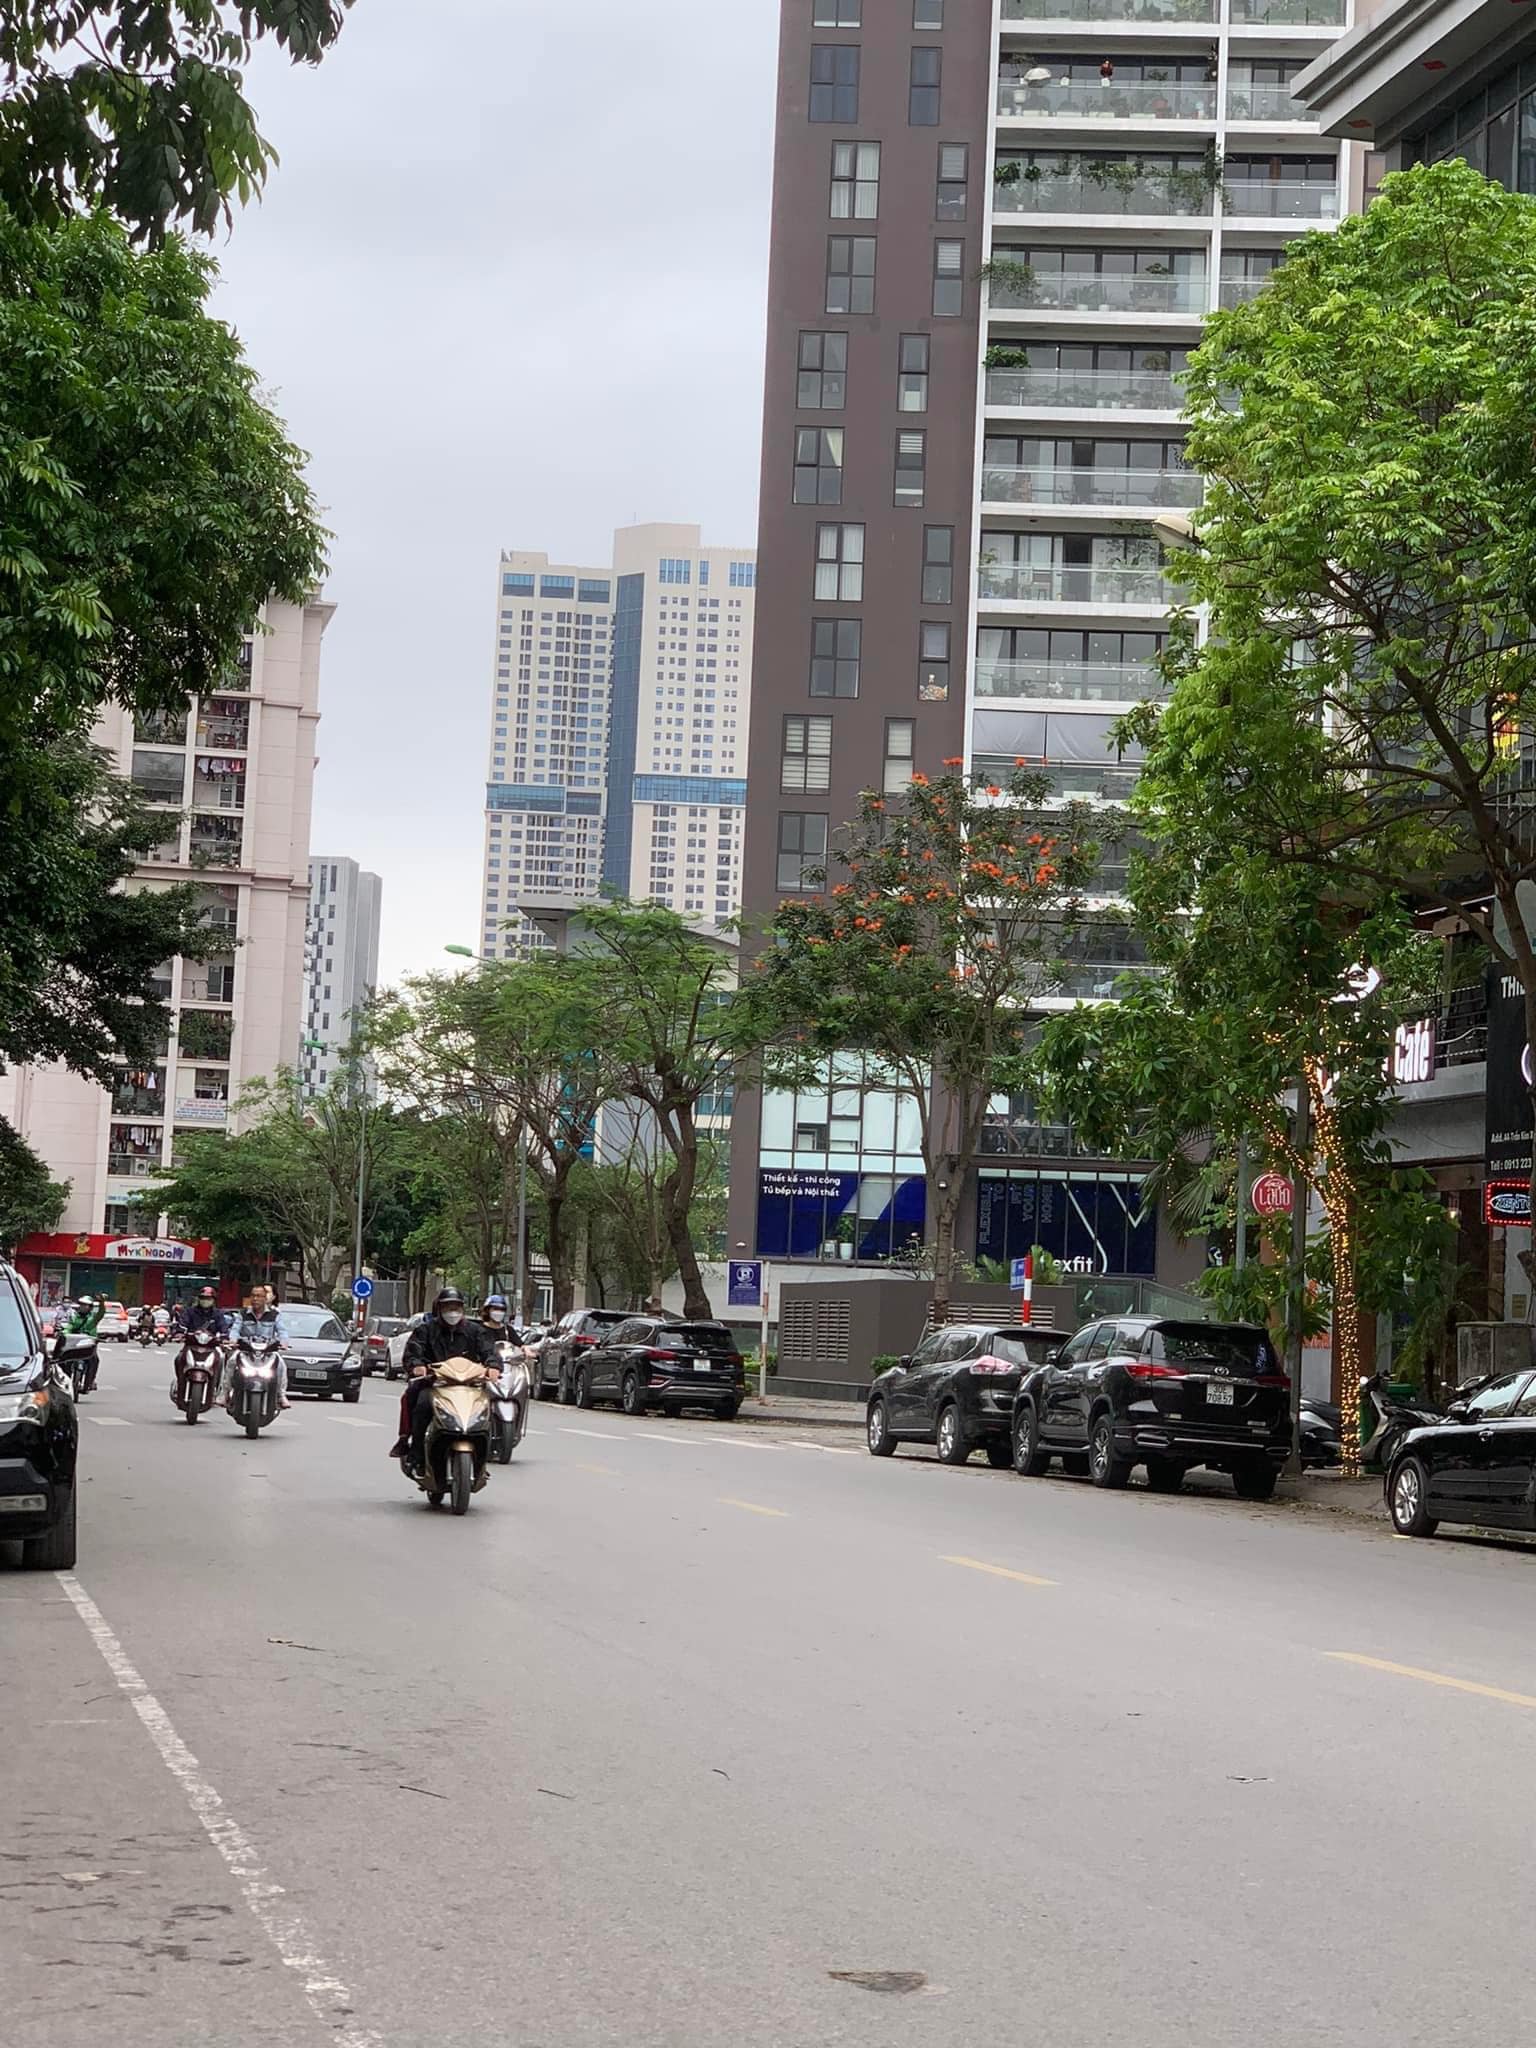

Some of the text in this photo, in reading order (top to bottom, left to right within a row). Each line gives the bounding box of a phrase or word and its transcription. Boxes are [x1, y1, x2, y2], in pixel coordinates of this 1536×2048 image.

[1394, 1018, 1431, 1082] Café
[763, 1172, 785, 1182] Thiết
[819, 1176, 840, 1186] công
[775, 1185, 791, 1196] bếp
[792, 1186, 803, 1195] và
[820, 1187, 840, 1197] thất
[1040, 1255, 1093, 1273] exfit
